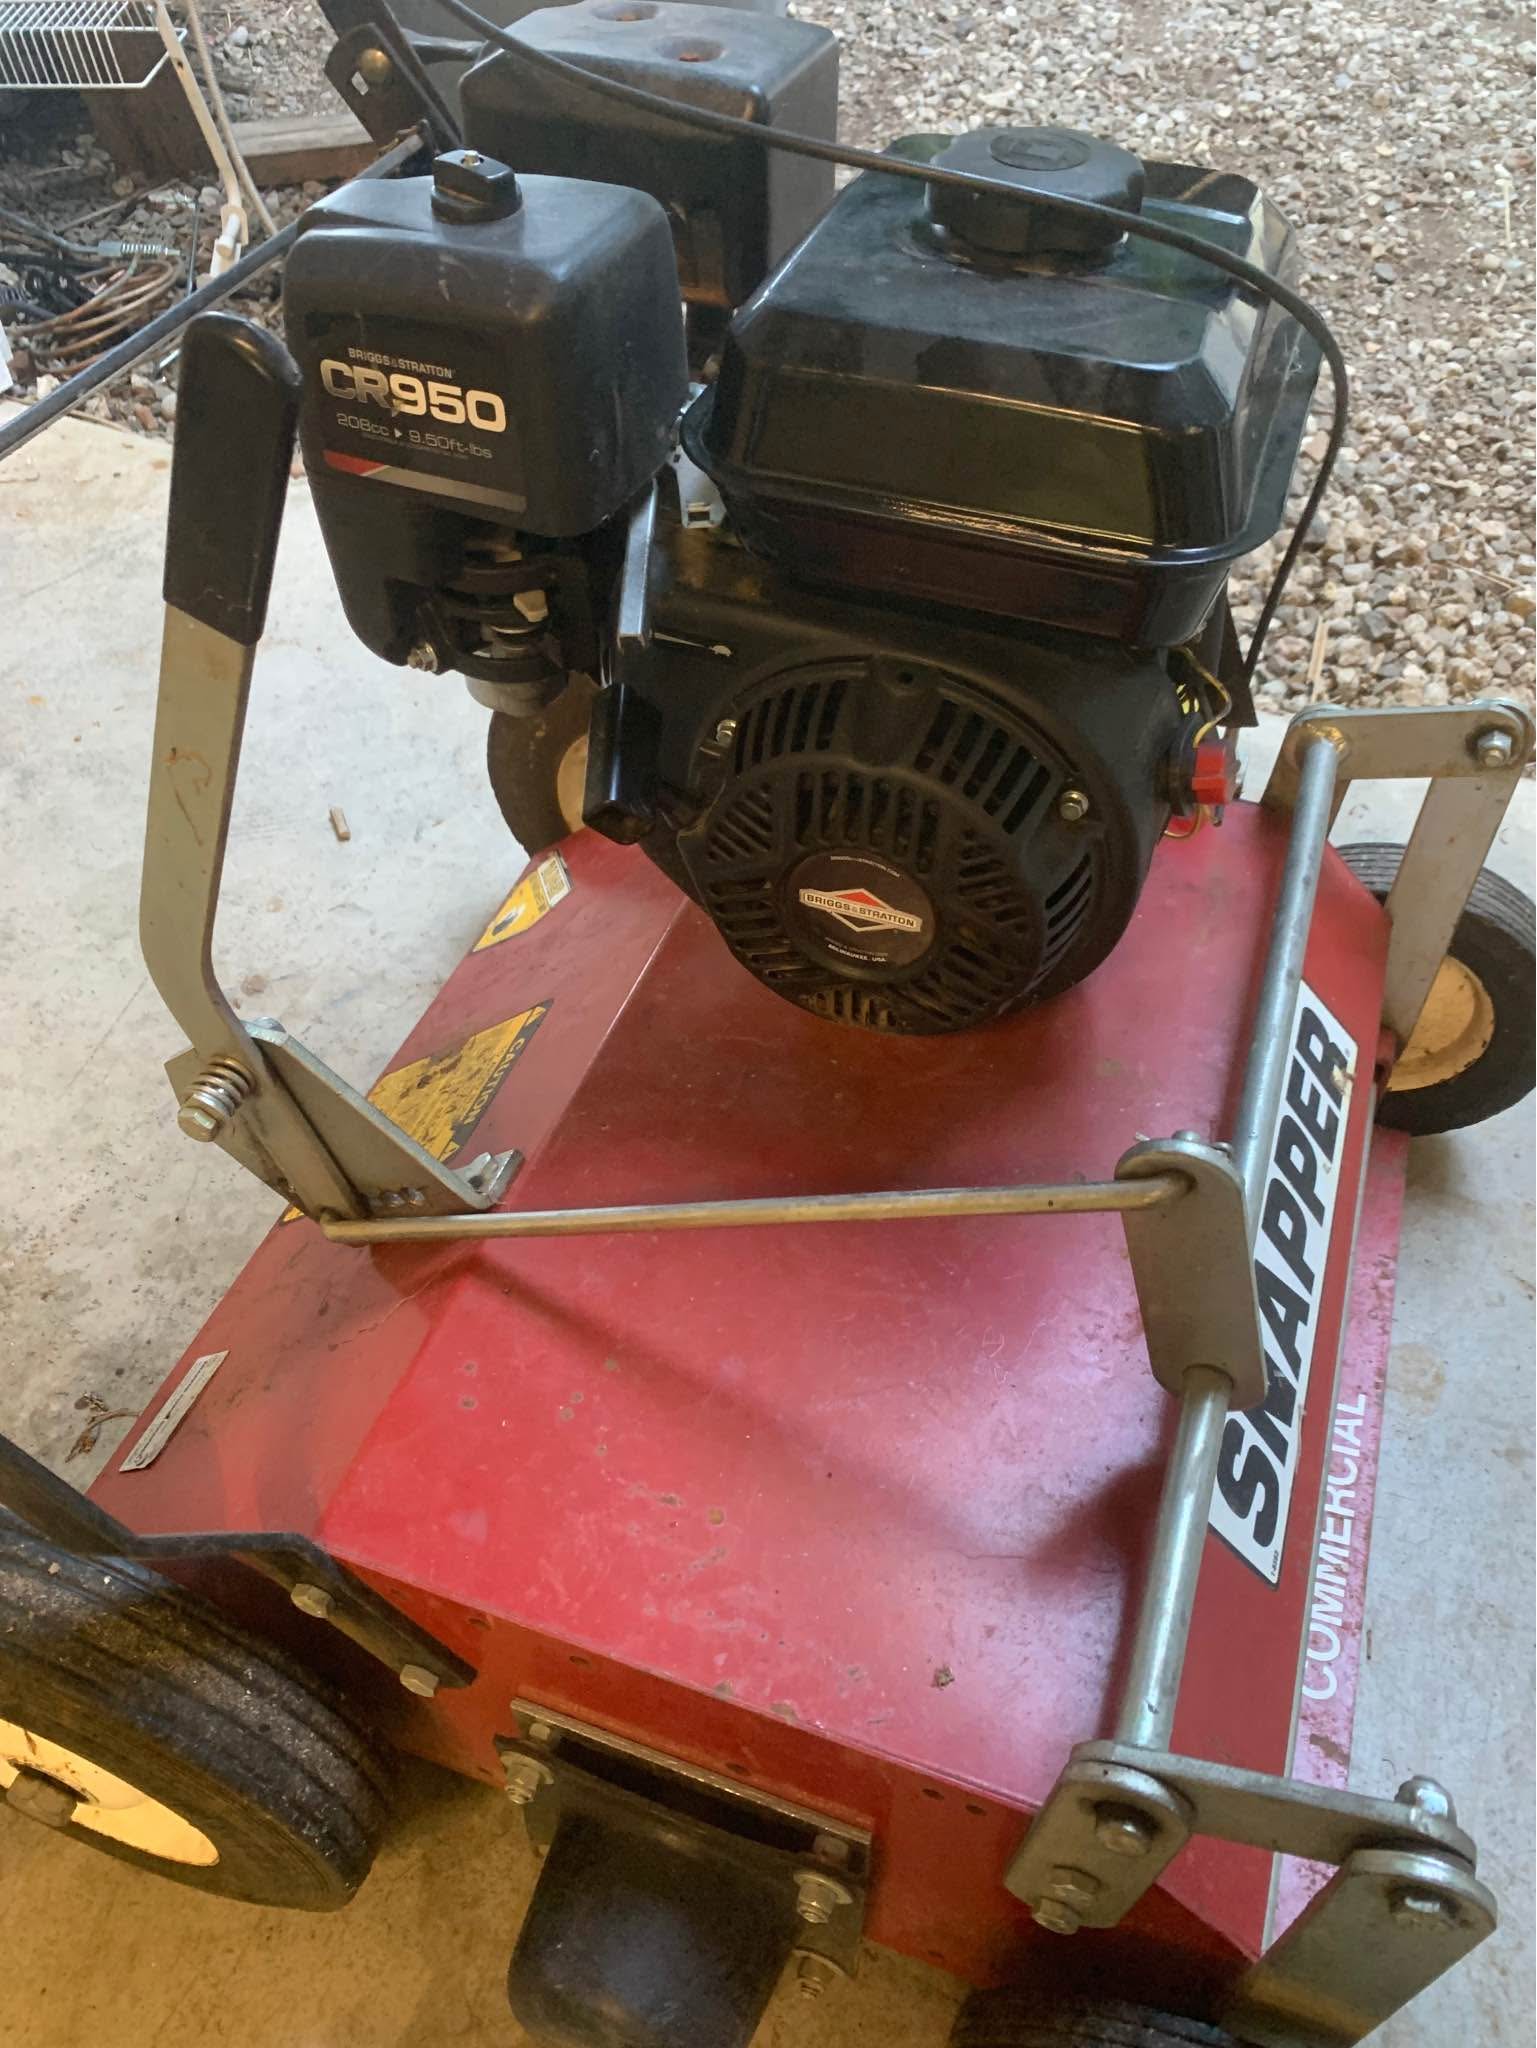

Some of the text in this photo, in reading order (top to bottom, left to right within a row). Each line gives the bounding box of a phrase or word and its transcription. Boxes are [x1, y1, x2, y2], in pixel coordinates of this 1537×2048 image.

[320, 359, 507, 432] CR950
[336, 414, 389, 436] 208cc
[409, 430, 493, 459] 9.50ft-lbs
[463, 1038, 525, 1125] CAUTION
[1217, 1007, 1348, 1547] SNAPPER
[1302, 1394, 1367, 1700] COMMERCIAL
